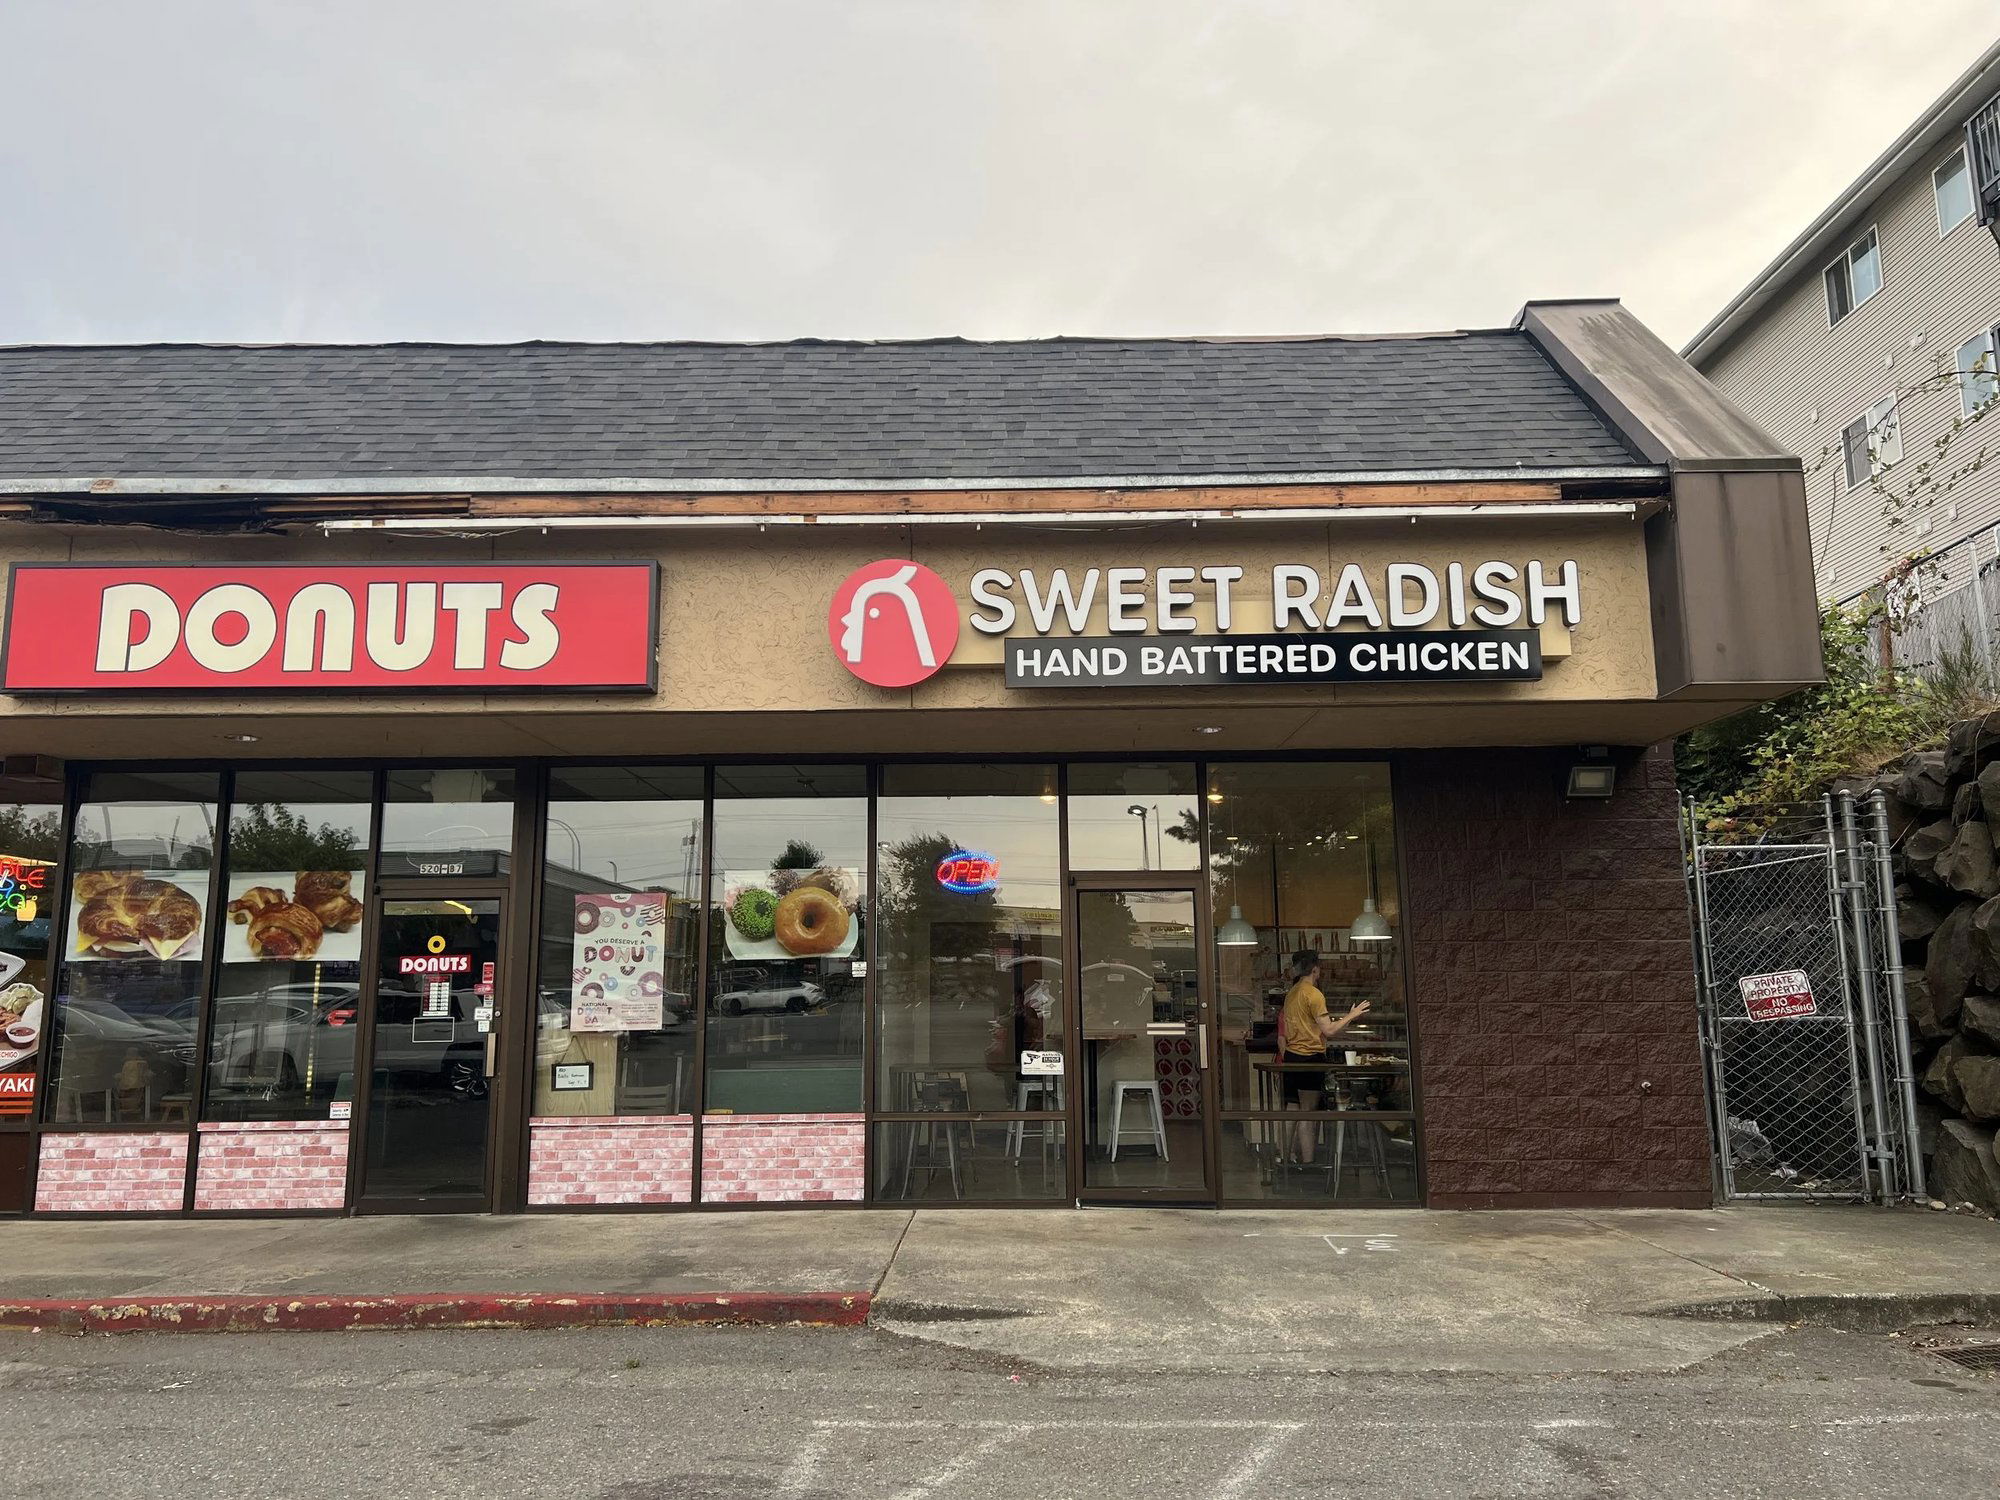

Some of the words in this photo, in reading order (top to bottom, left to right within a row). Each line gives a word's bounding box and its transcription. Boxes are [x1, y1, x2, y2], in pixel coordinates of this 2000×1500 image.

[968, 564, 1244, 636] SWEET
[1273, 559, 1582, 632] RADISH
[95, 581, 561, 673] DONUTS
[1016, 645, 1129, 678] HAND
[1141, 641, 1337, 676] BATTERED
[1348, 639, 1530, 672] CHICKEN
[937, 860, 1001, 882] OPEN
[610, 938, 639, 946] DESERVE
[584, 945, 658, 964] DONUT
[401, 957, 468, 973] DONUTS
[1753, 975, 1795, 988] PRIVATE
[1750, 984, 1802, 998] PROPERTY
[1771, 997, 1788, 1008] NO
[1751, 1003, 1814, 1020] TRESPASSING
